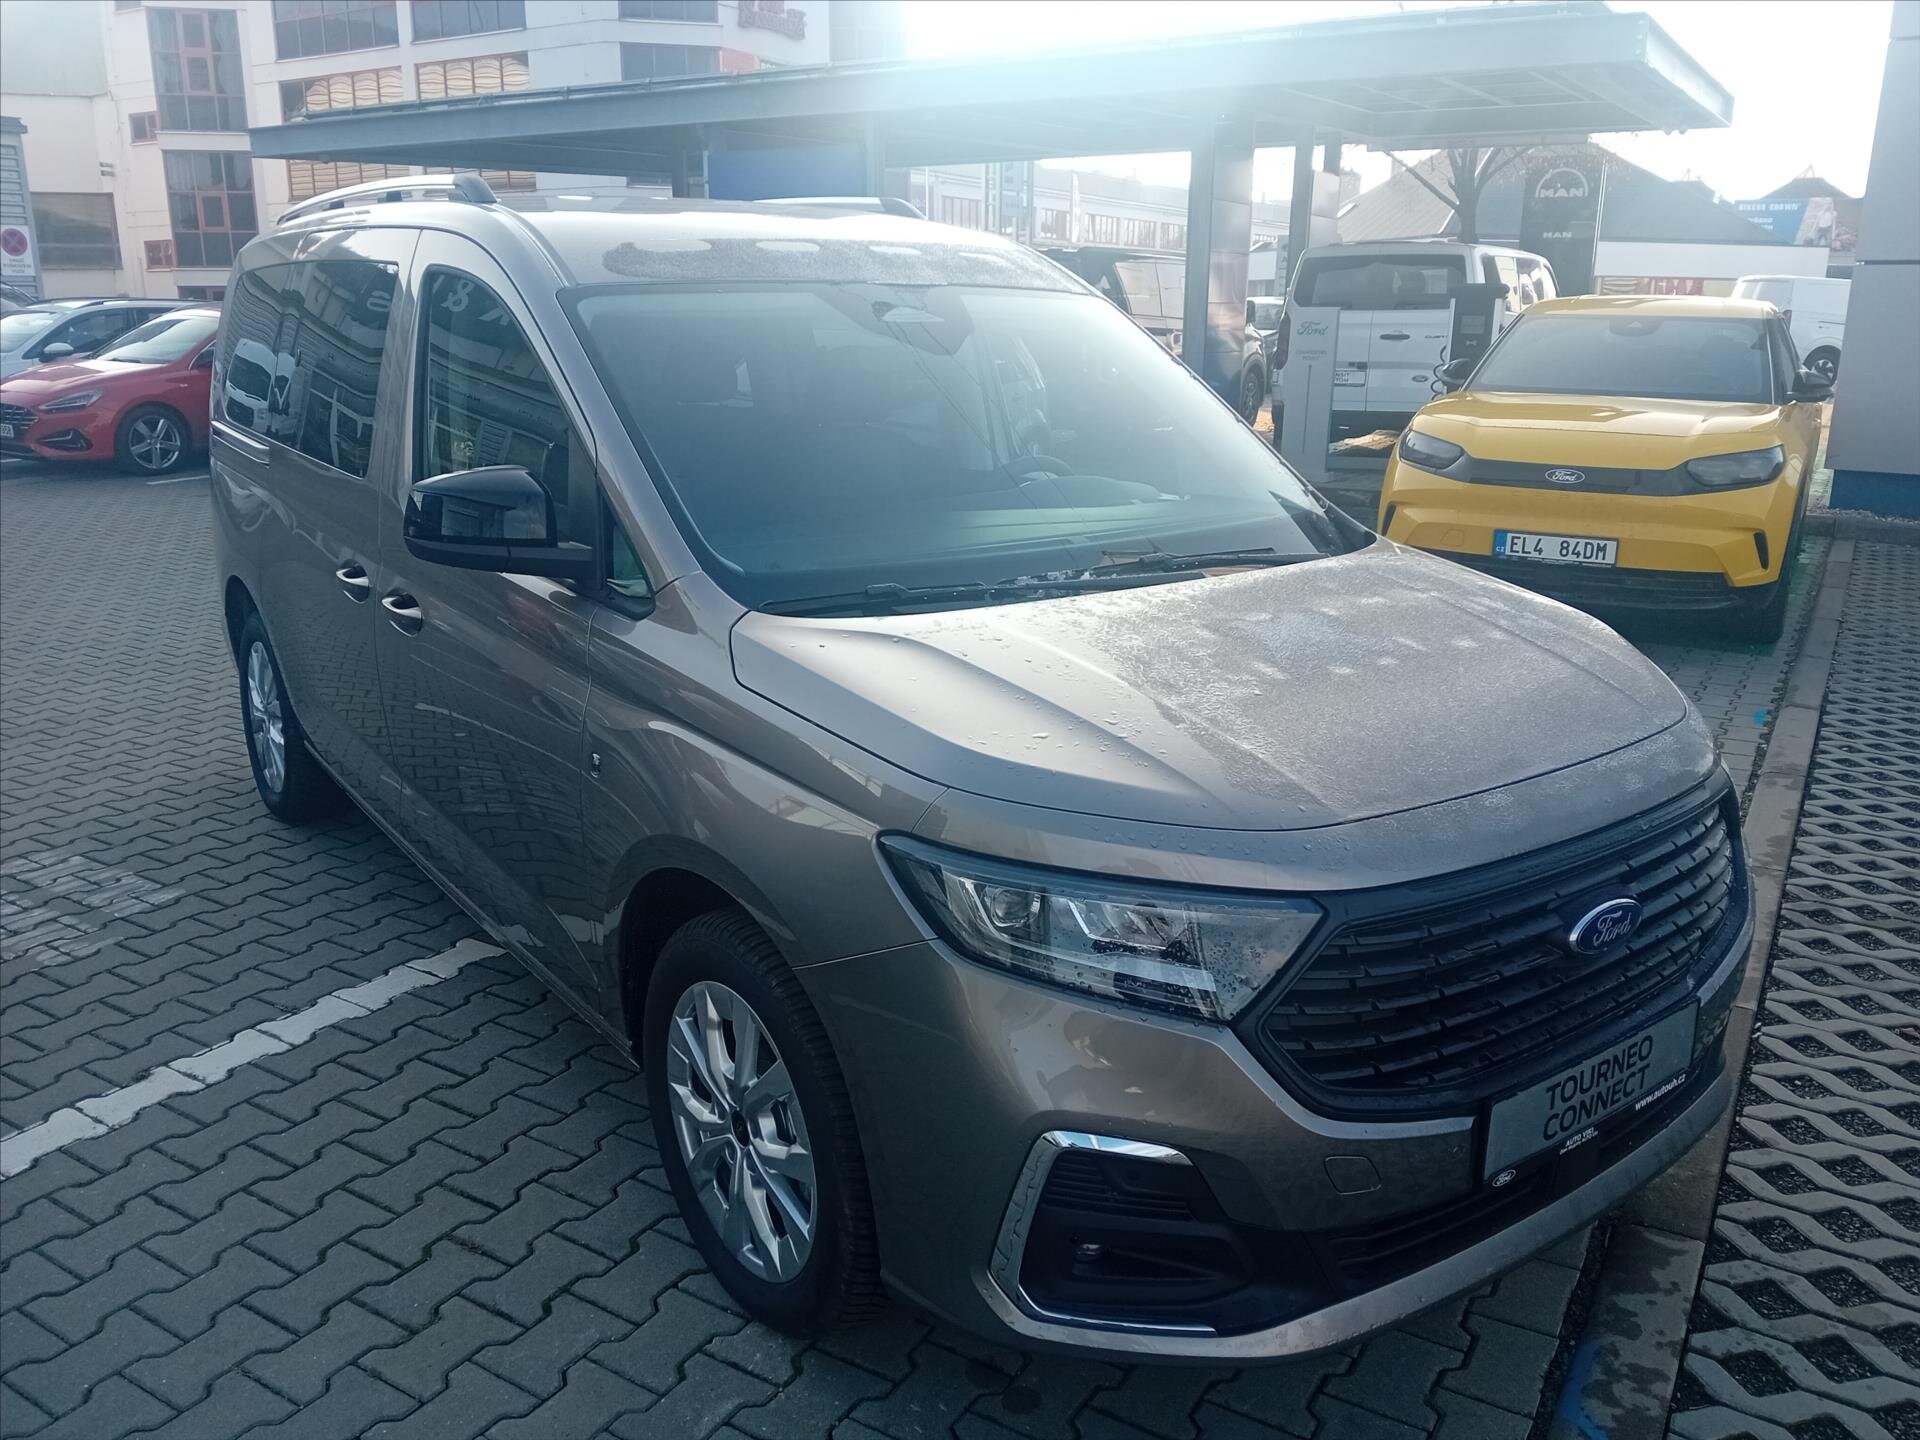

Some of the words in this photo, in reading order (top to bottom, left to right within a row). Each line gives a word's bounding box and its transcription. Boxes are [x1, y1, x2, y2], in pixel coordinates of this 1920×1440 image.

[1540, 188, 1584, 198] MAN
[1542, 231, 1572, 239] MAN
[1297, 320, 1328, 336] Ford
[1552, 470, 1578, 481] Ford
[1509, 535, 1544, 556] EL4
[1559, 540, 1608, 561] 84DM
[1593, 910, 1632, 947] Ford
[1546, 1035, 1653, 1110] TOURNEO
[1543, 1064, 1651, 1141] CONNECT
